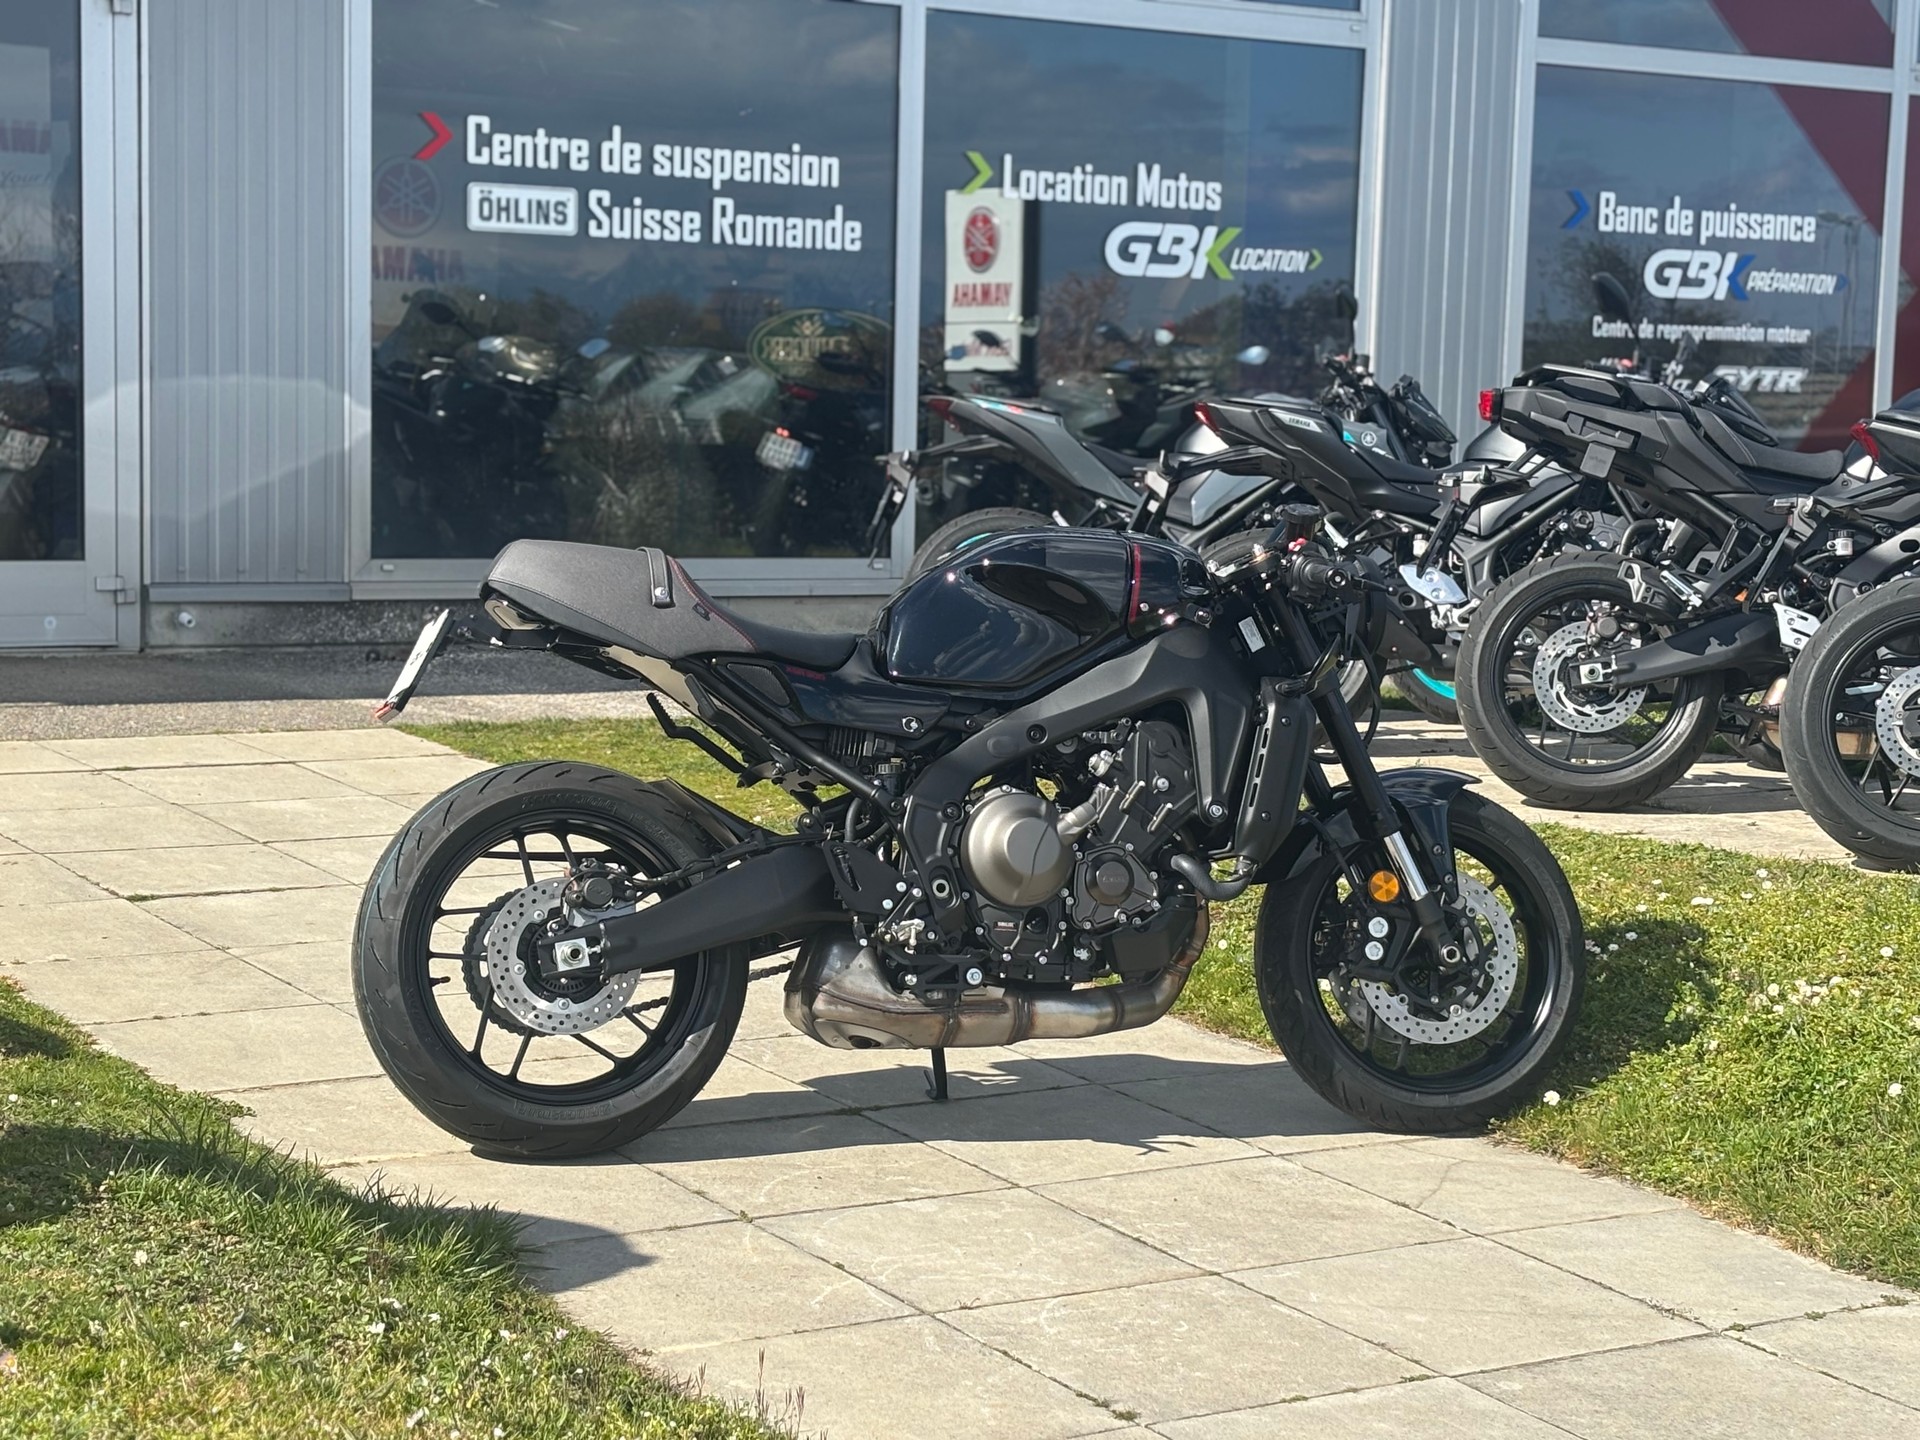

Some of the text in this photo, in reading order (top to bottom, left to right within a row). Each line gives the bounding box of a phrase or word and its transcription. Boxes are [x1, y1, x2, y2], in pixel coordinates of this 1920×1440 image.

[466, 114, 841, 190] Centre de suspension
[1003, 153, 1222, 211] Location Motos
[478, 188, 863, 252] ÖHLINS Suisse Romande
[1598, 191, 1817, 246] Banc de puissance
[1231, 247, 1309, 273] LOCATION
[1746, 268, 1837, 295] PRÉPARATION
[1638, 317, 1655, 339] de
[1766, 325, 1811, 344] moteur
